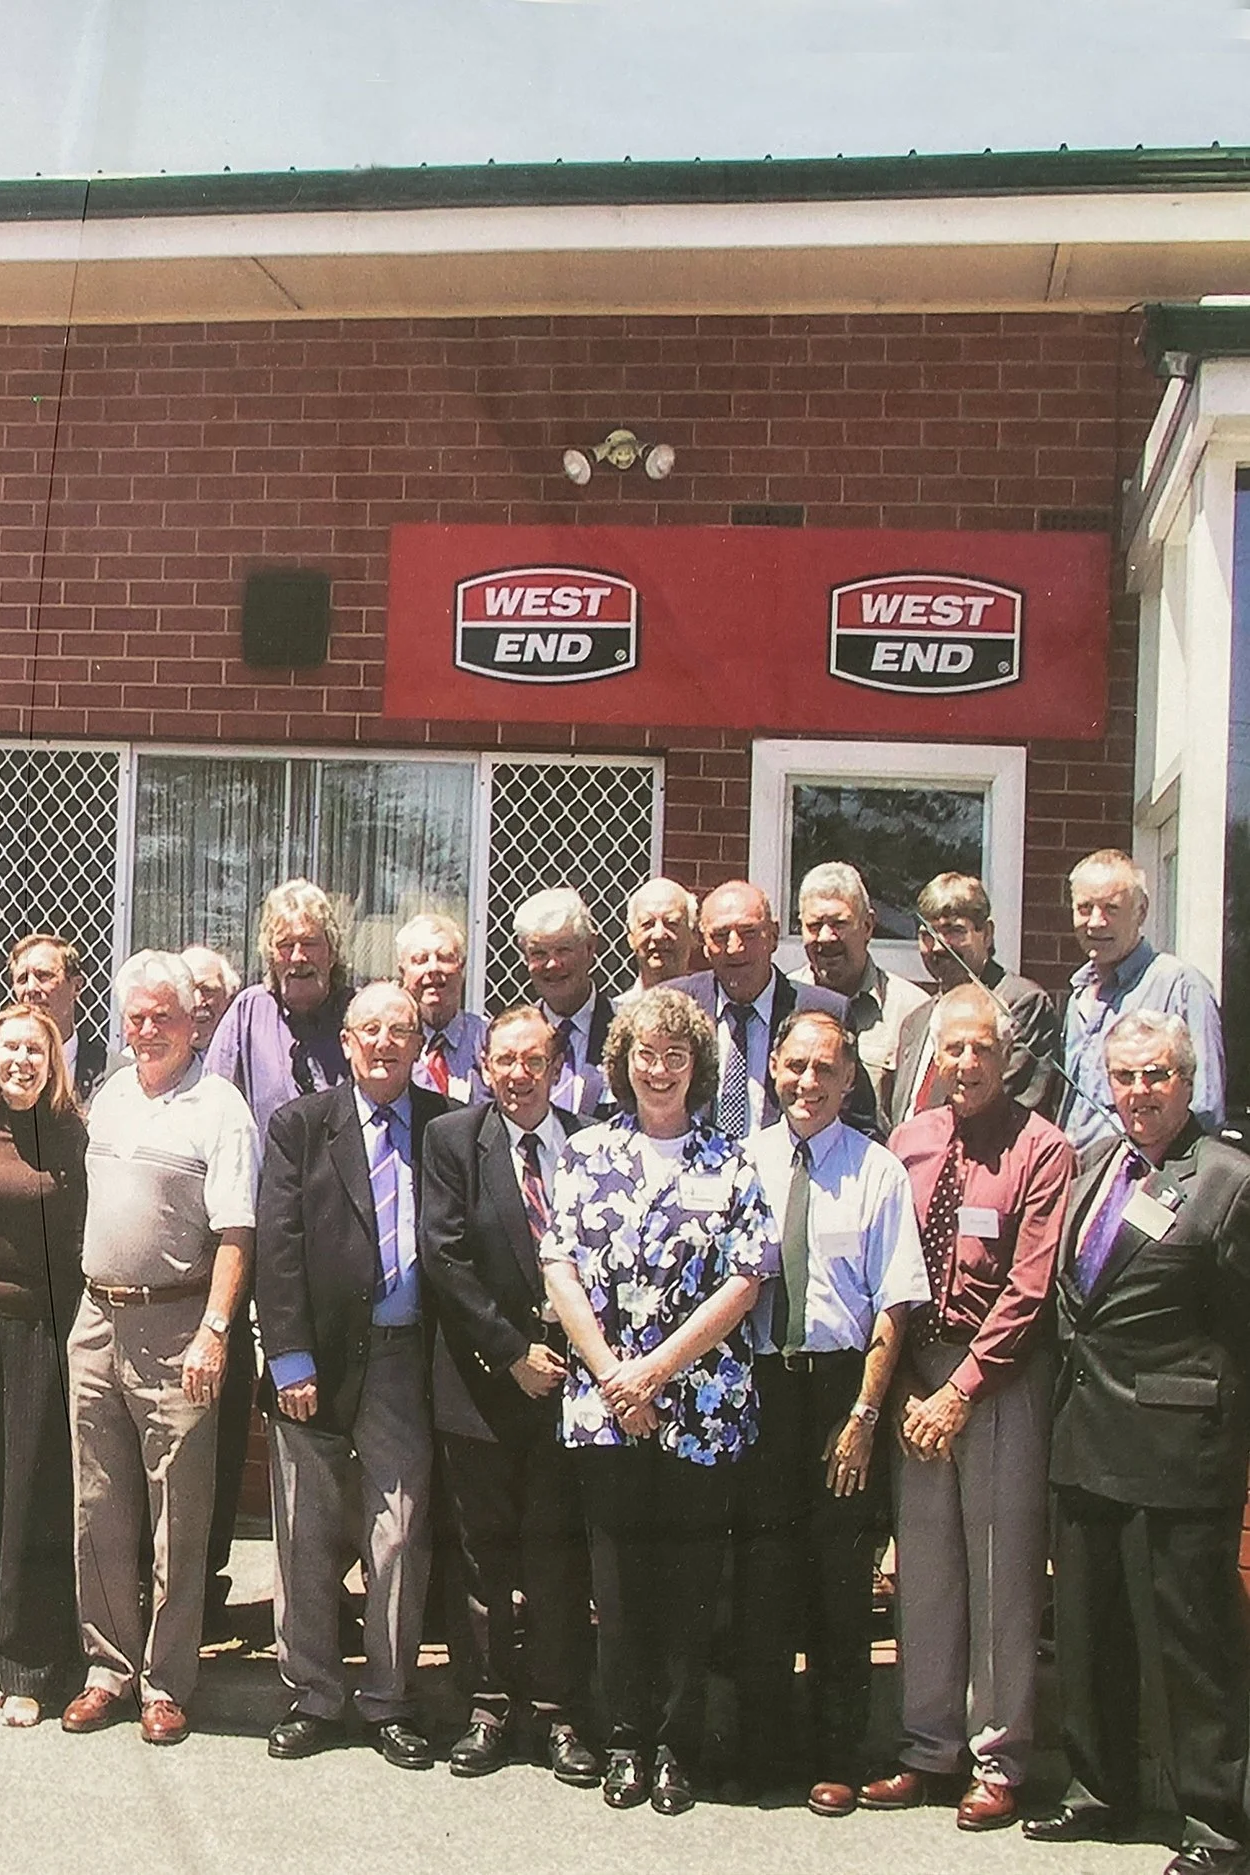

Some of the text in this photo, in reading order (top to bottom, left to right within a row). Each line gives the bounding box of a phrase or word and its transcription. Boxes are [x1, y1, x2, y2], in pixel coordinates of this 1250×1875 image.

[485, 587, 612, 617] WEST
[861, 593, 995, 626] WEST
[493, 633, 593, 663] END
[871, 642, 974, 674] END
